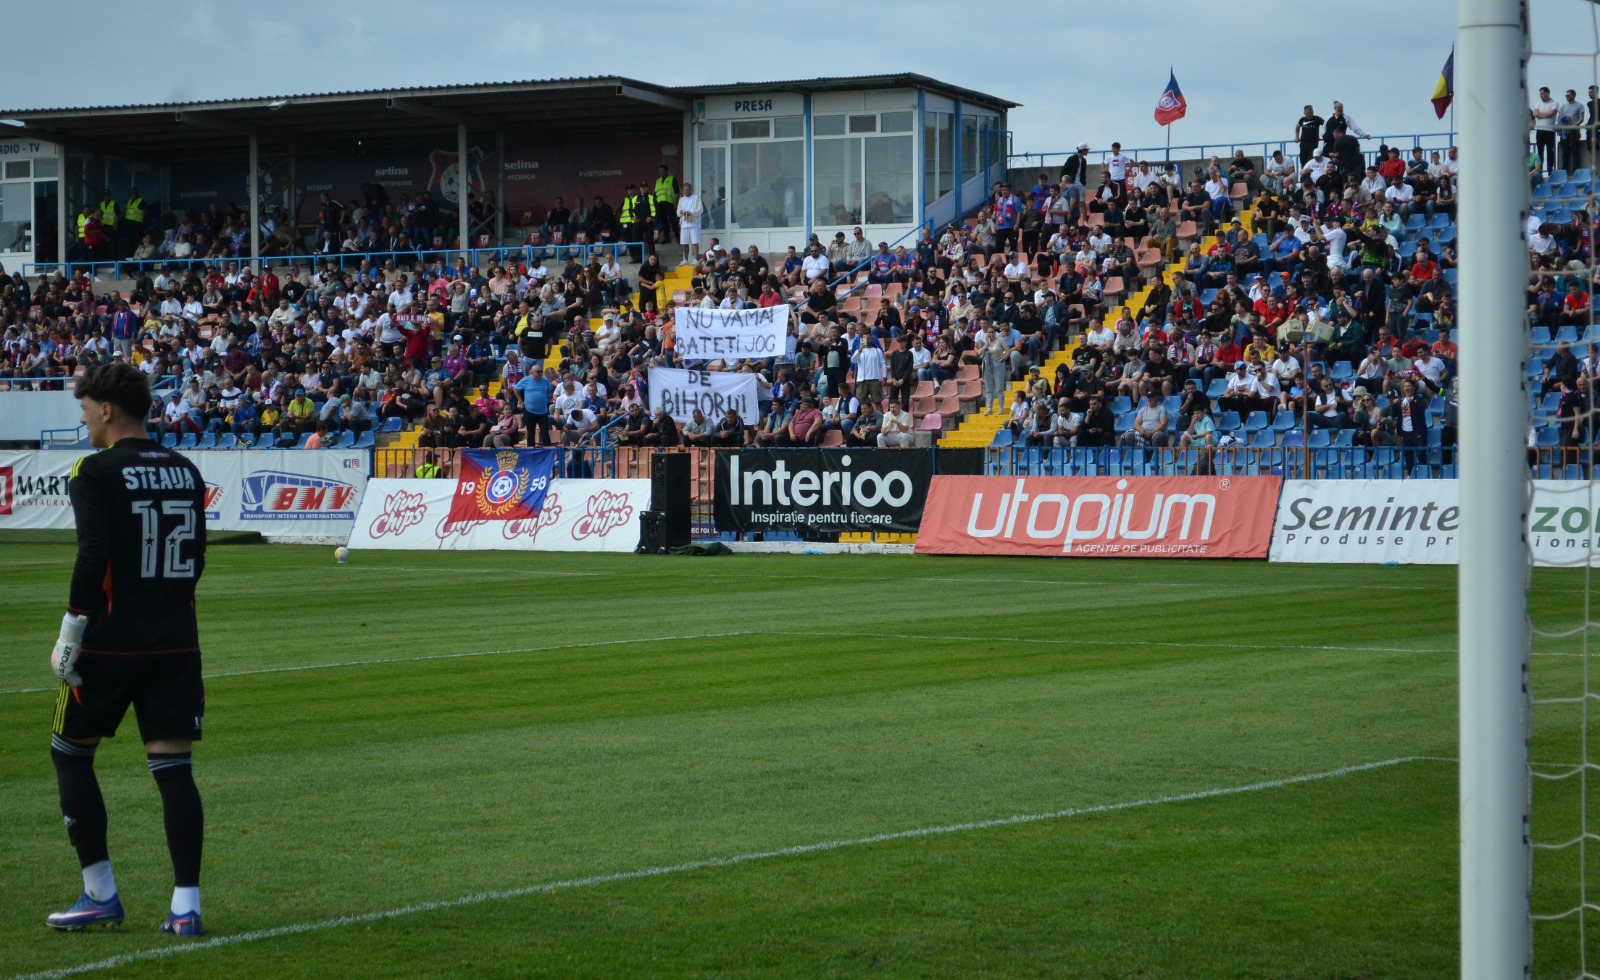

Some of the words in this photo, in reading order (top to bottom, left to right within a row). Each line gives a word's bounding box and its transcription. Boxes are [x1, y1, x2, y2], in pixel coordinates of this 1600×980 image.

[734, 99, 773, 113] PRESA
[28, 142, 41, 152] TV
[686, 309, 713, 329] NU
[687, 370, 712, 387] DE
[121, 466, 195, 490] STEAUA
[460, 481, 476, 496] 19
[529, 475, 547, 492] 58
[730, 454, 913, 507] Interioo
[272, 486, 353, 511] BMV
[384, 489, 423, 514] Viva
[587, 489, 629, 516] Viva
[369, 504, 427, 539] Chips
[571, 504, 633, 541] Chips
[808, 511, 847, 525] pentru
[850, 510, 893, 524] fiecare
[967, 478, 1216, 553] utopium
[1282, 496, 1459, 532] Seminte
[131, 500, 197, 578] 12
[1122, 543, 1138, 553] DE
[1139, 543, 1207, 554] PUBLICITATE
[1286, 533, 1404, 546] Produse
[1426, 536, 1454, 548] pr
